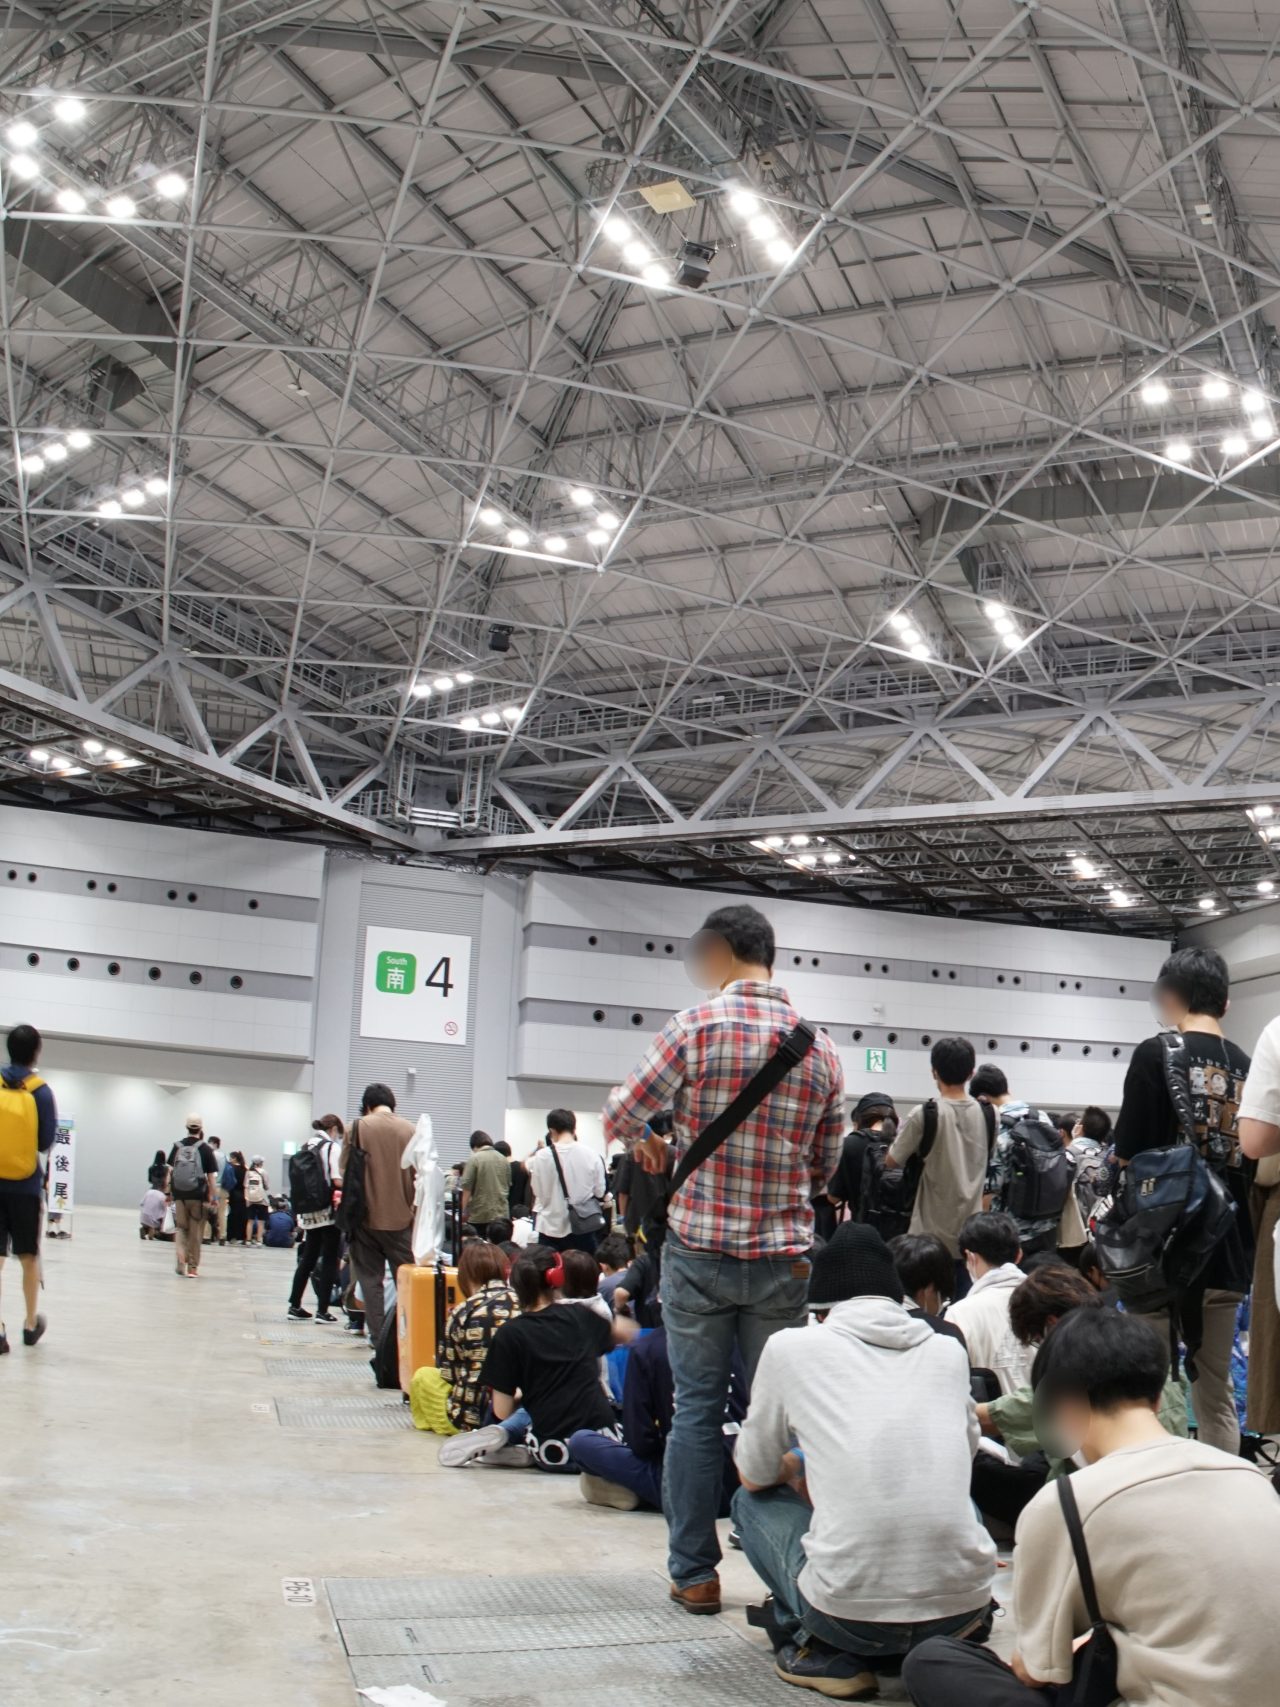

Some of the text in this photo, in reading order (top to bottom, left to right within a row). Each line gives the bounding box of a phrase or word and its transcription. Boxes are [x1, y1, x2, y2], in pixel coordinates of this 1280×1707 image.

[386, 956, 408, 965] South
[387, 956, 454, 997] 南 4
[54, 1128, 71, 1199] 最後尾
[284, 1580, 312, 1602] P6-10
